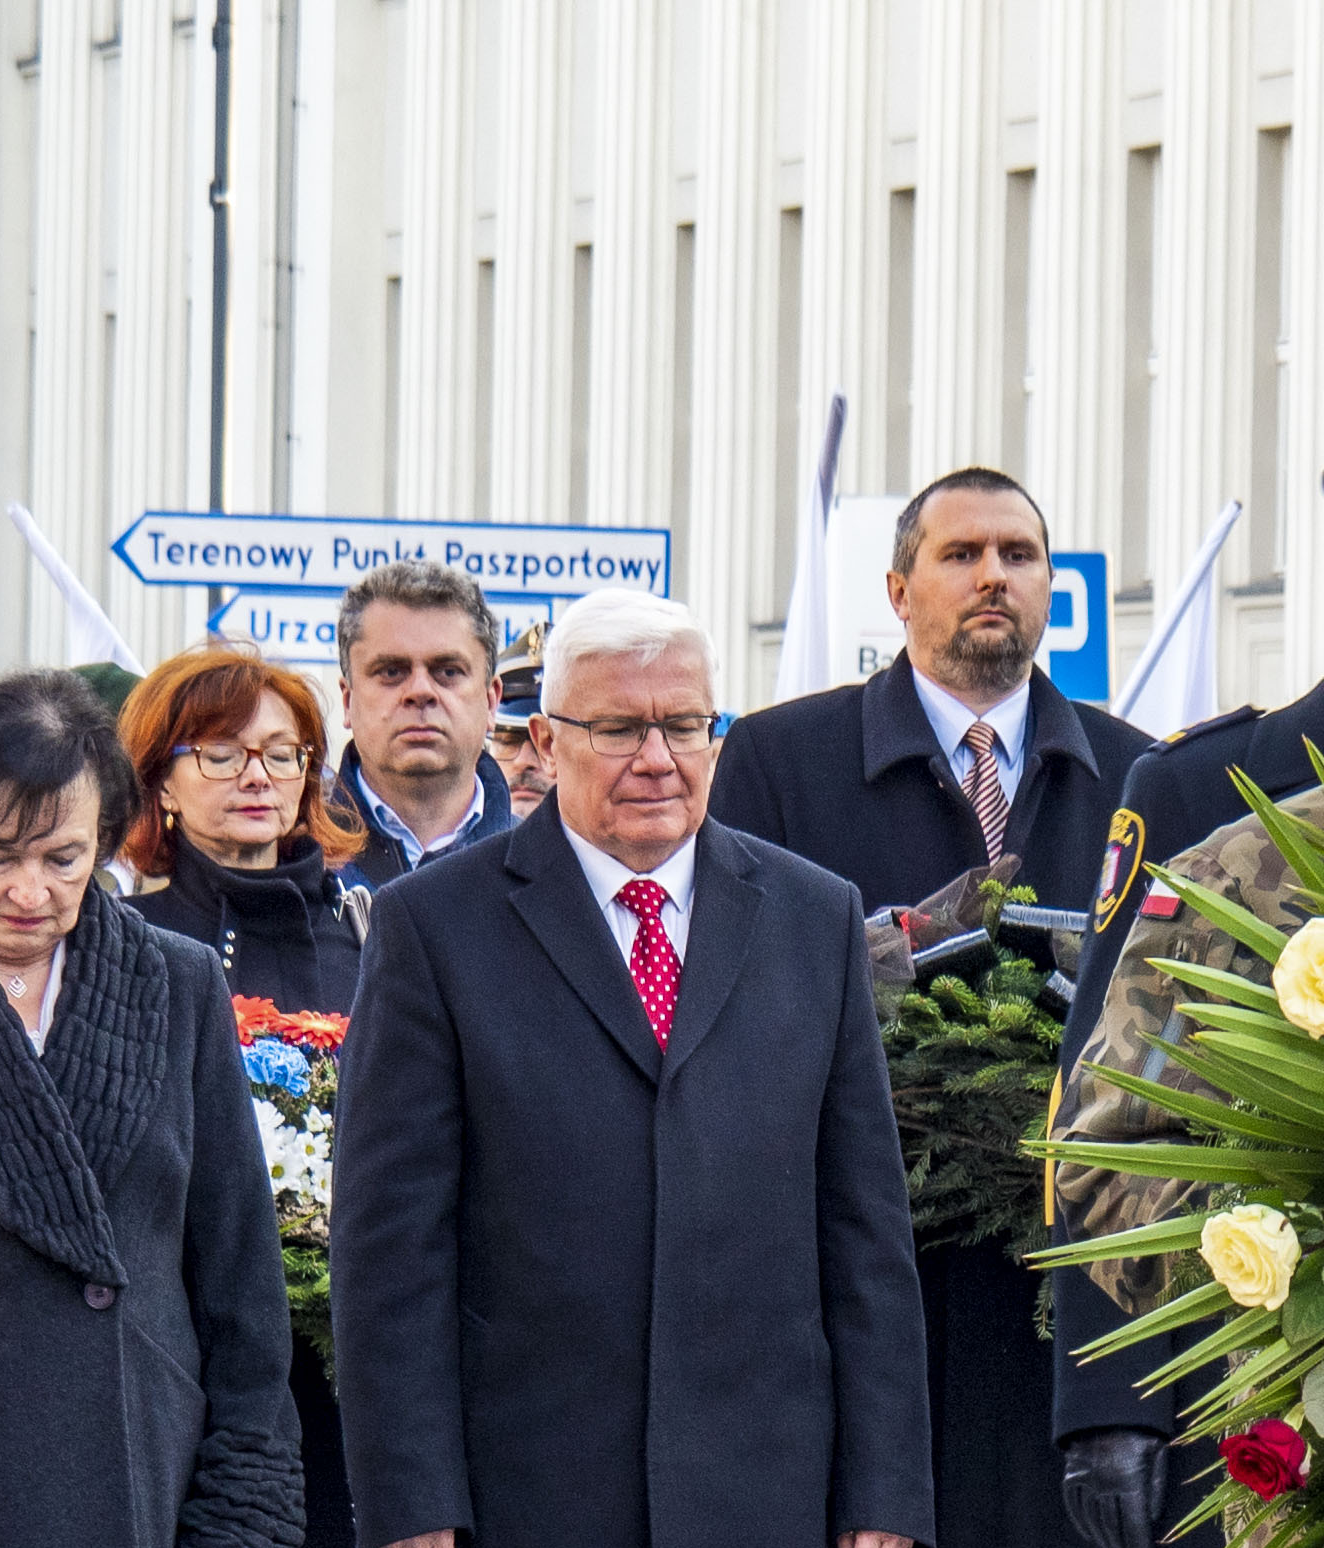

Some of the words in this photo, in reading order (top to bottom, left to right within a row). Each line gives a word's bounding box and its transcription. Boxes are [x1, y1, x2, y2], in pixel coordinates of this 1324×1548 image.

[148, 532, 313, 580] Terenowy
[446, 541, 661, 591] Paszportowy
[250, 609, 337, 656] Urzą
